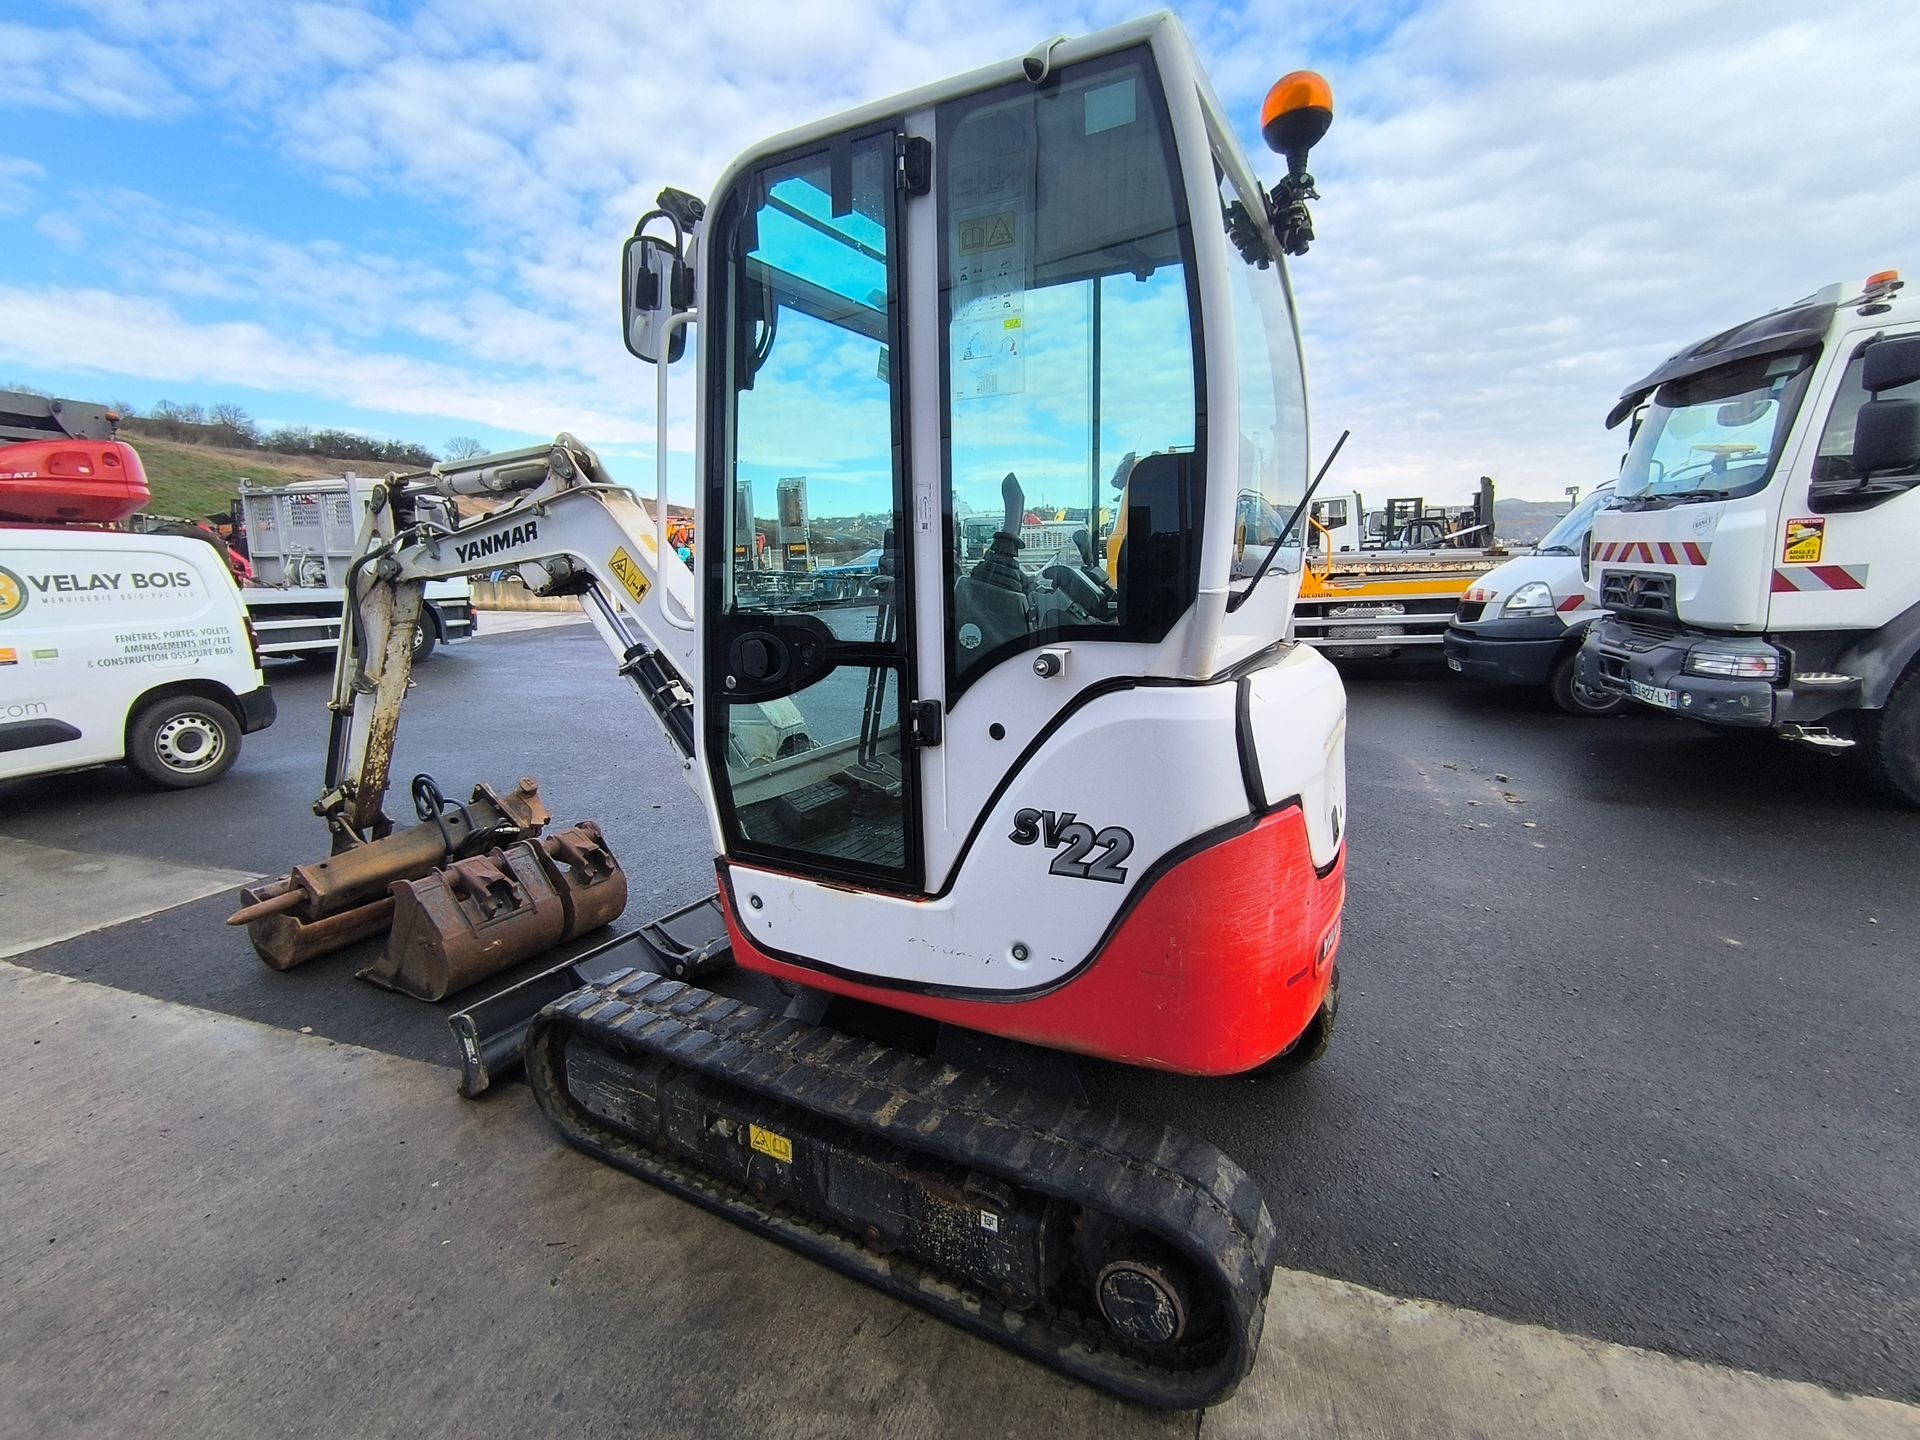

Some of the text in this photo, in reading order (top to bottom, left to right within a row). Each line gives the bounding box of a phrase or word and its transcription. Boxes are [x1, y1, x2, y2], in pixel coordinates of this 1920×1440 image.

[455, 521, 538, 564] YANMAR
[27, 572, 191, 592] VELAY BOIS
[41, 594, 112, 604] MENUISERIE
[200, 626, 229, 636] VOLETS
[97, 652, 169, 668] CONSTRUCTION
[171, 648, 212, 661] OSSATURE
[215, 646, 234, 656] BOIS
[1008, 807, 1134, 884] SV22
